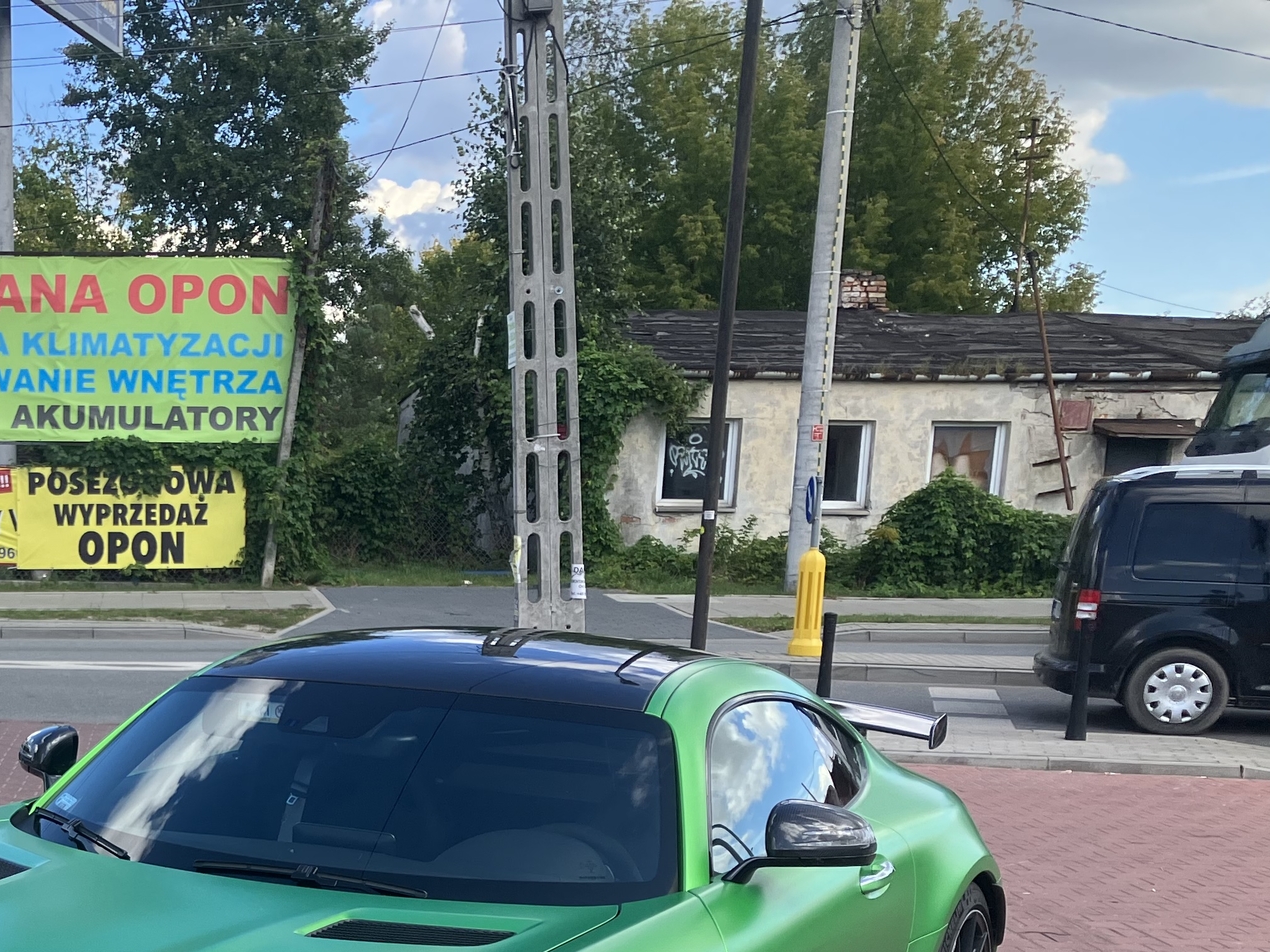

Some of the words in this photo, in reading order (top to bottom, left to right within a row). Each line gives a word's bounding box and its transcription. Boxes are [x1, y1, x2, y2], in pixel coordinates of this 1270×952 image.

[128, 274, 289, 314] OPON
[23, 332, 283, 359] KLIMATYZACJI
[108, 369, 283, 400] WNĘTRZA
[11, 405, 283, 431] AKUMULATORY
[28, 471, 236, 495] POSEZOWA
[79, 531, 184, 564] OPON
